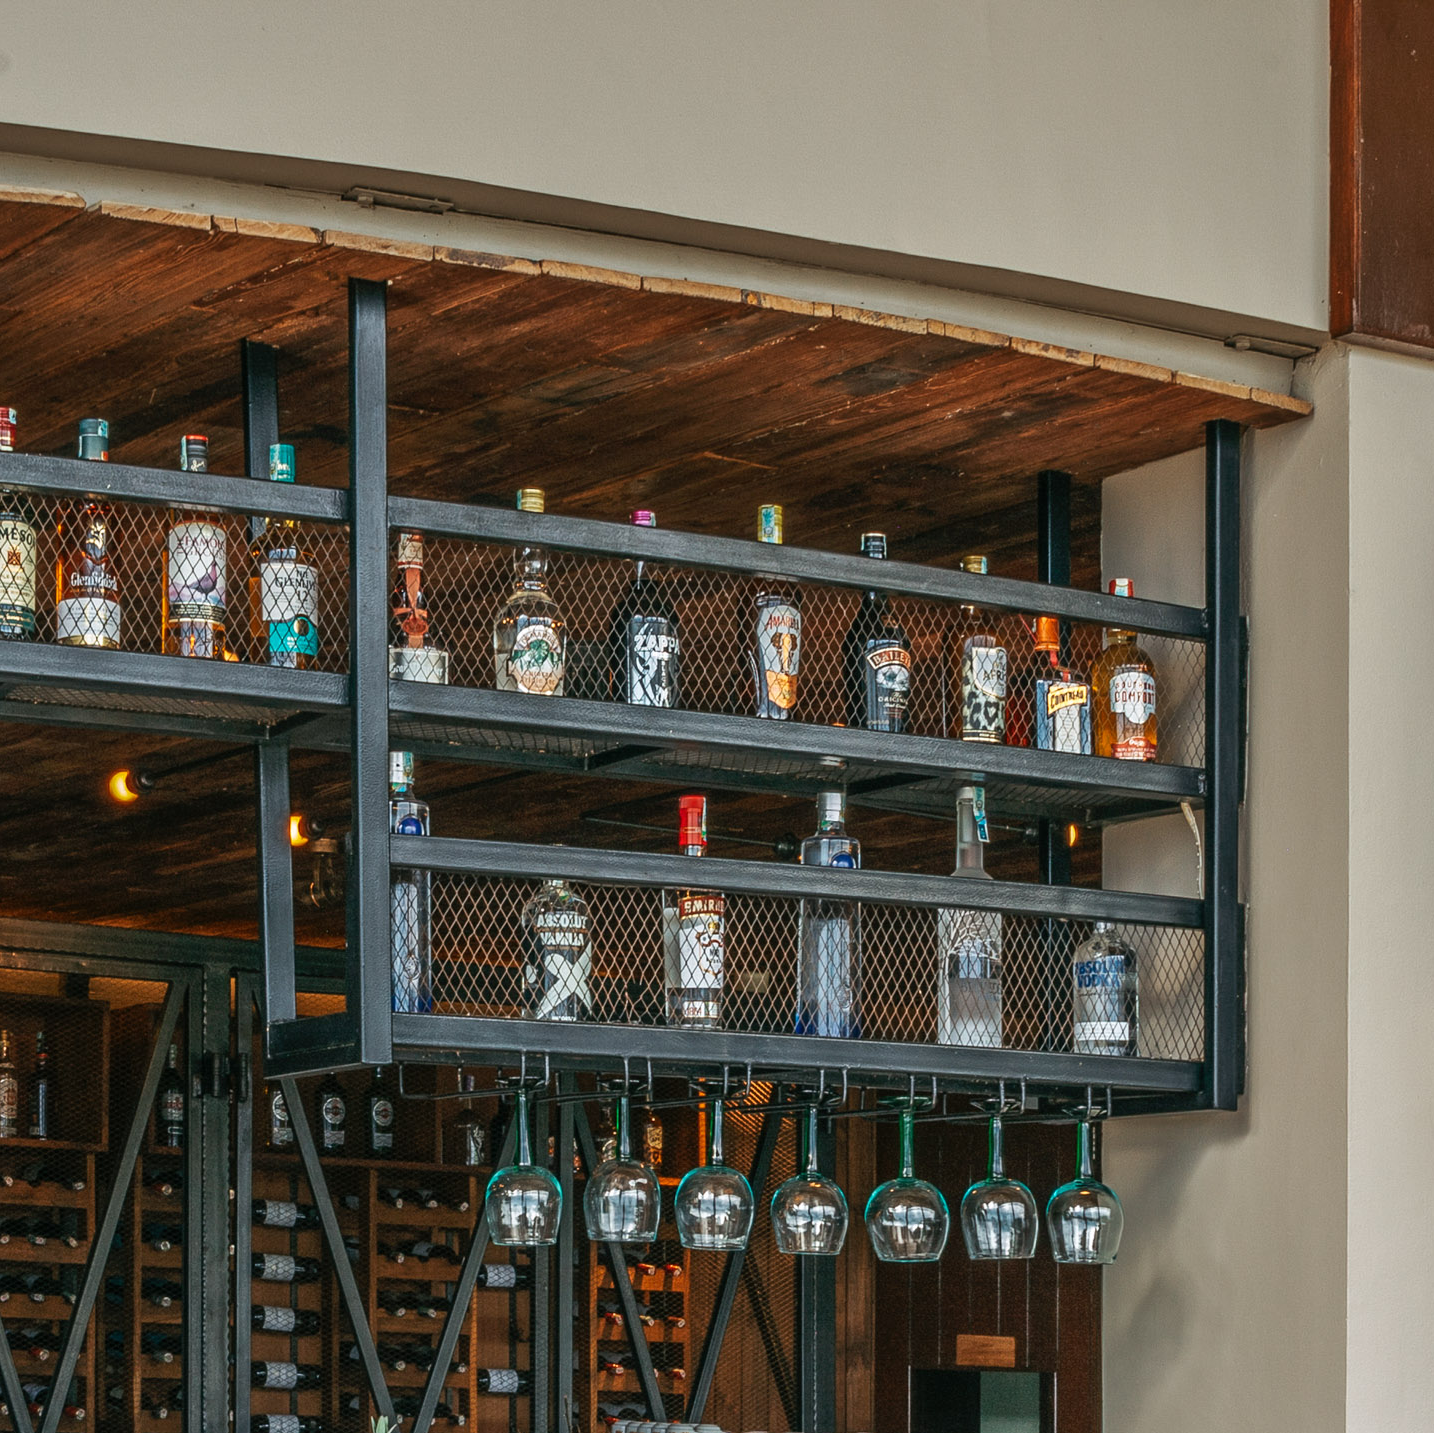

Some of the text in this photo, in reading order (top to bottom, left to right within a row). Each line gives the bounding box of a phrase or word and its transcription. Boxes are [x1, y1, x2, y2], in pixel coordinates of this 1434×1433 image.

[633, 634, 681, 655] ZAPPA
[1114, 690, 1155, 705] COMFORT
[536, 913, 588, 929] ABSOLUT
[1077, 975, 1120, 988] VODKA
